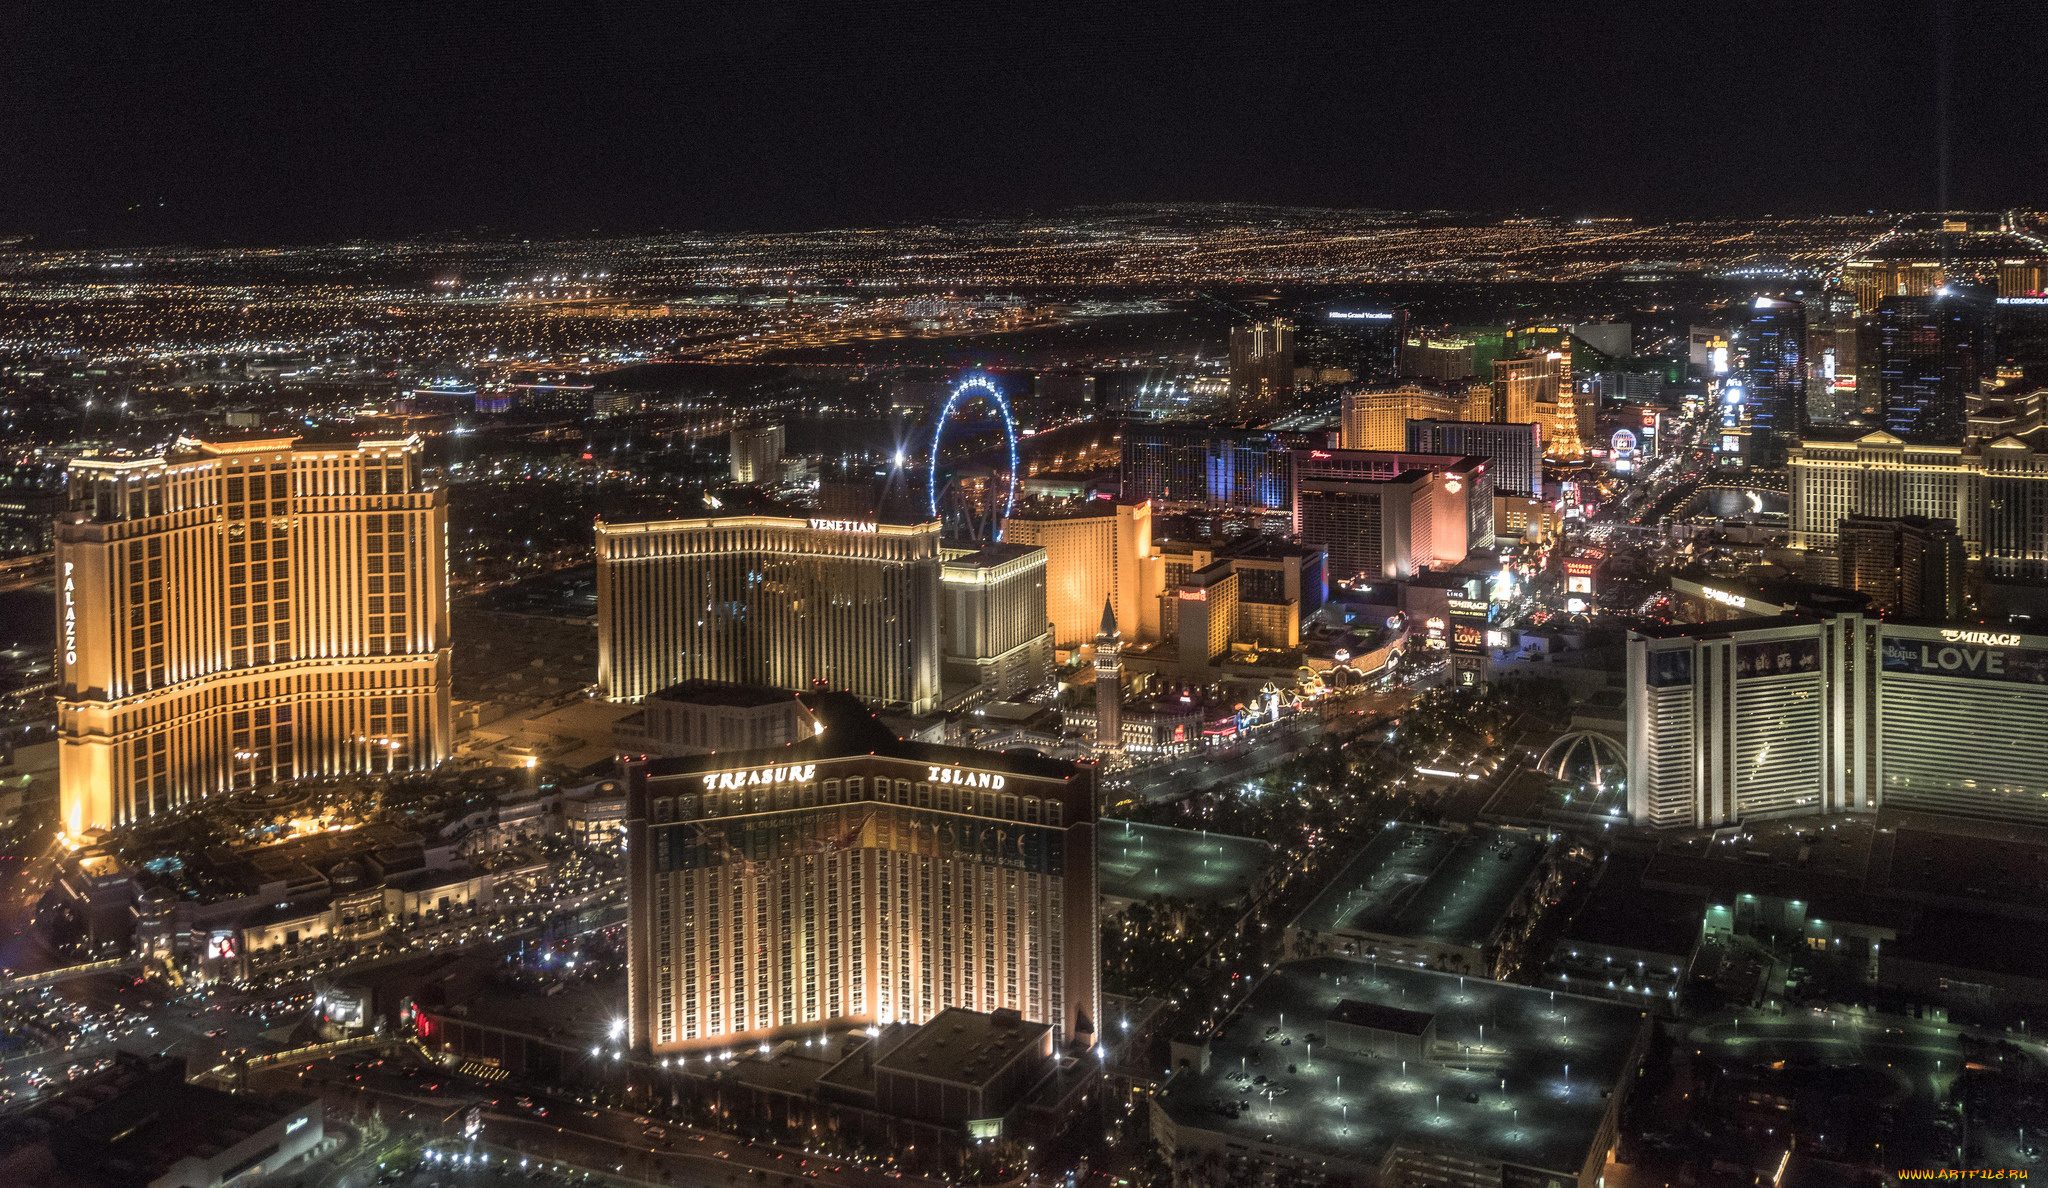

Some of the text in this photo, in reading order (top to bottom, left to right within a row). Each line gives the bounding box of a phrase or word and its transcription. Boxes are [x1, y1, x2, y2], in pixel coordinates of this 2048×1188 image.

[810, 519, 877, 533] VENETIAN
[64, 562, 77, 665] PALAZZO
[1450, 600, 1488, 610] MIRAGE
[1454, 633, 1482, 644] LOVE
[1940, 629, 2022, 647] THE MIRAGE
[1887, 645, 1918, 661] BEATLES
[1921, 645, 2005, 674] LOVE
[702, 764, 816, 790] TREASURE
[927, 765, 1005, 790] ISLAND
